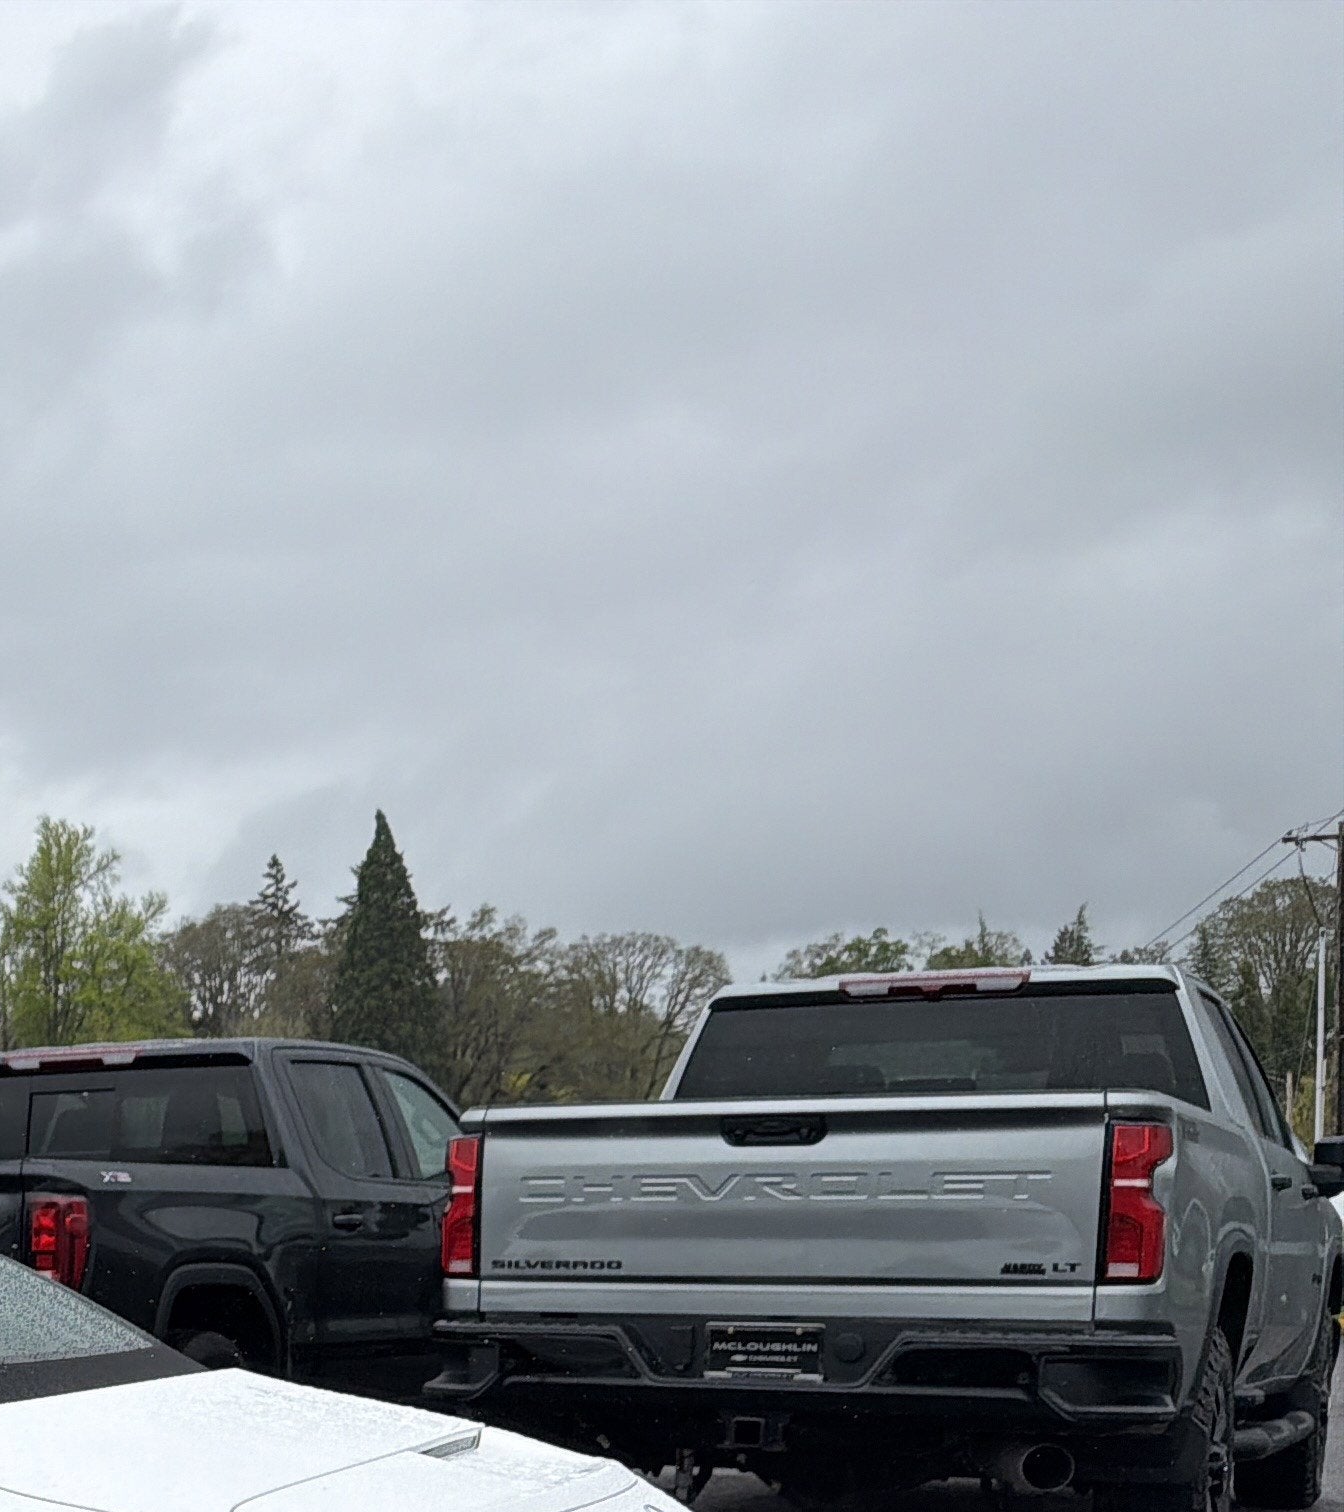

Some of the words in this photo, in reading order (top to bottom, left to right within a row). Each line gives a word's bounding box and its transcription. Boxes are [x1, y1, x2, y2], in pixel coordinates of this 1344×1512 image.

[518, 1169, 1052, 1201] CHEVROLET
[491, 1259, 623, 1271] SILVERADO
[1052, 1262, 1082, 1273] LT
[712, 1341, 819, 1353] MCLOUGHLIN
